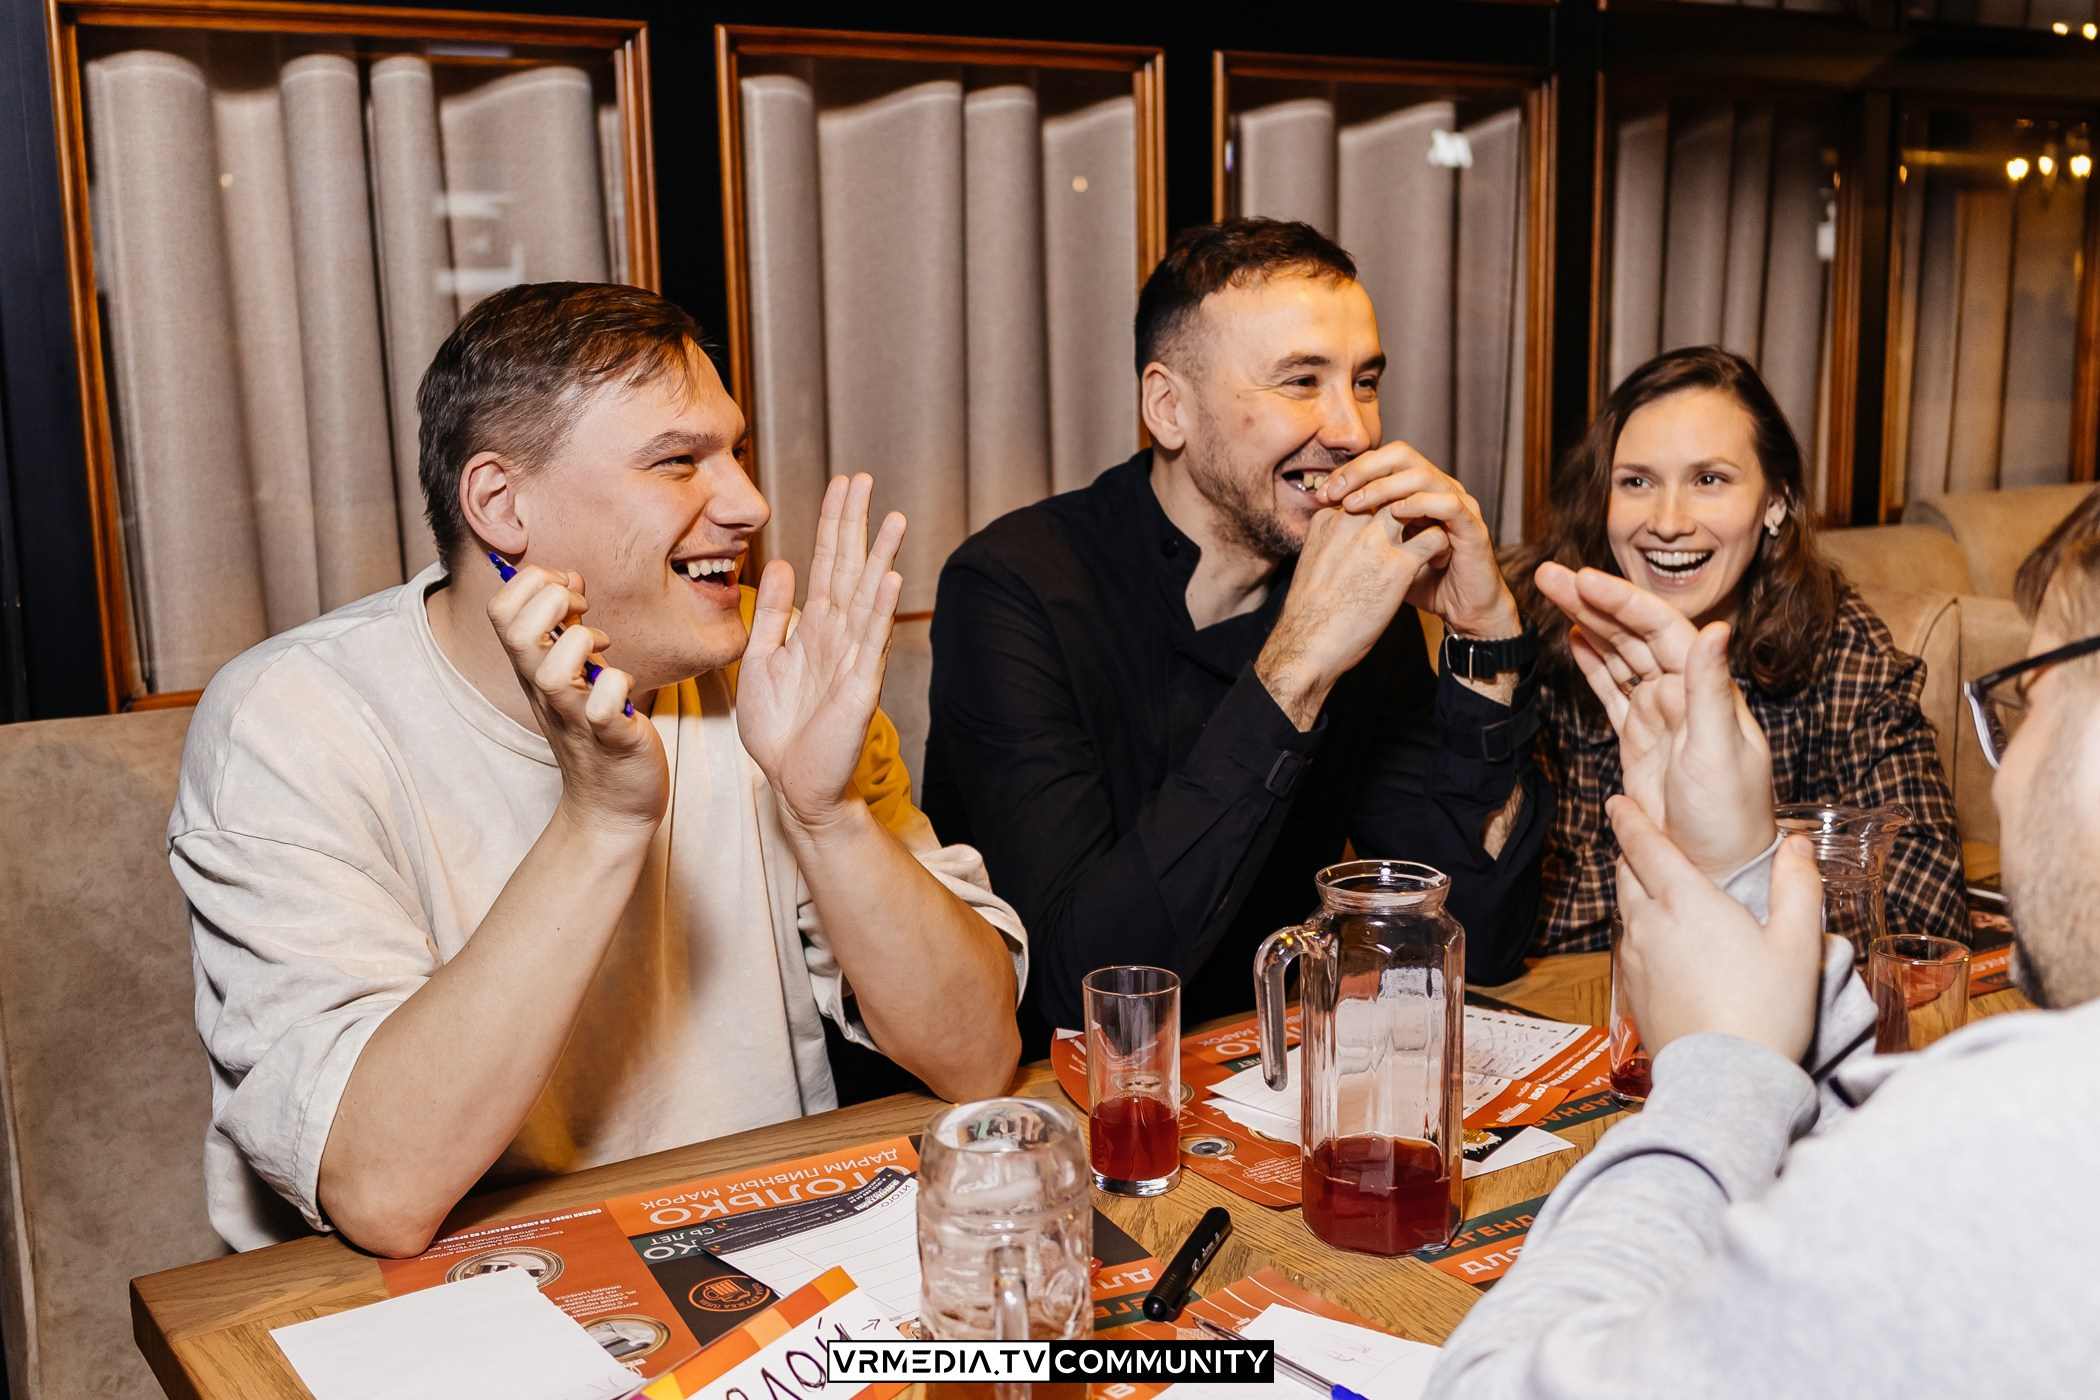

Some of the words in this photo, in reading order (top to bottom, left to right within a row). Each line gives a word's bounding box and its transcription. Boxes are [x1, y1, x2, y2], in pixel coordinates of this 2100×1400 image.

[824, 1148, 898, 1174] ДАРИМ
[726, 1167, 820, 1194] ПИВНЫХ
[640, 1188, 720, 1210] МАРОК
[650, 1232, 685, 1246] ЛЕТ
